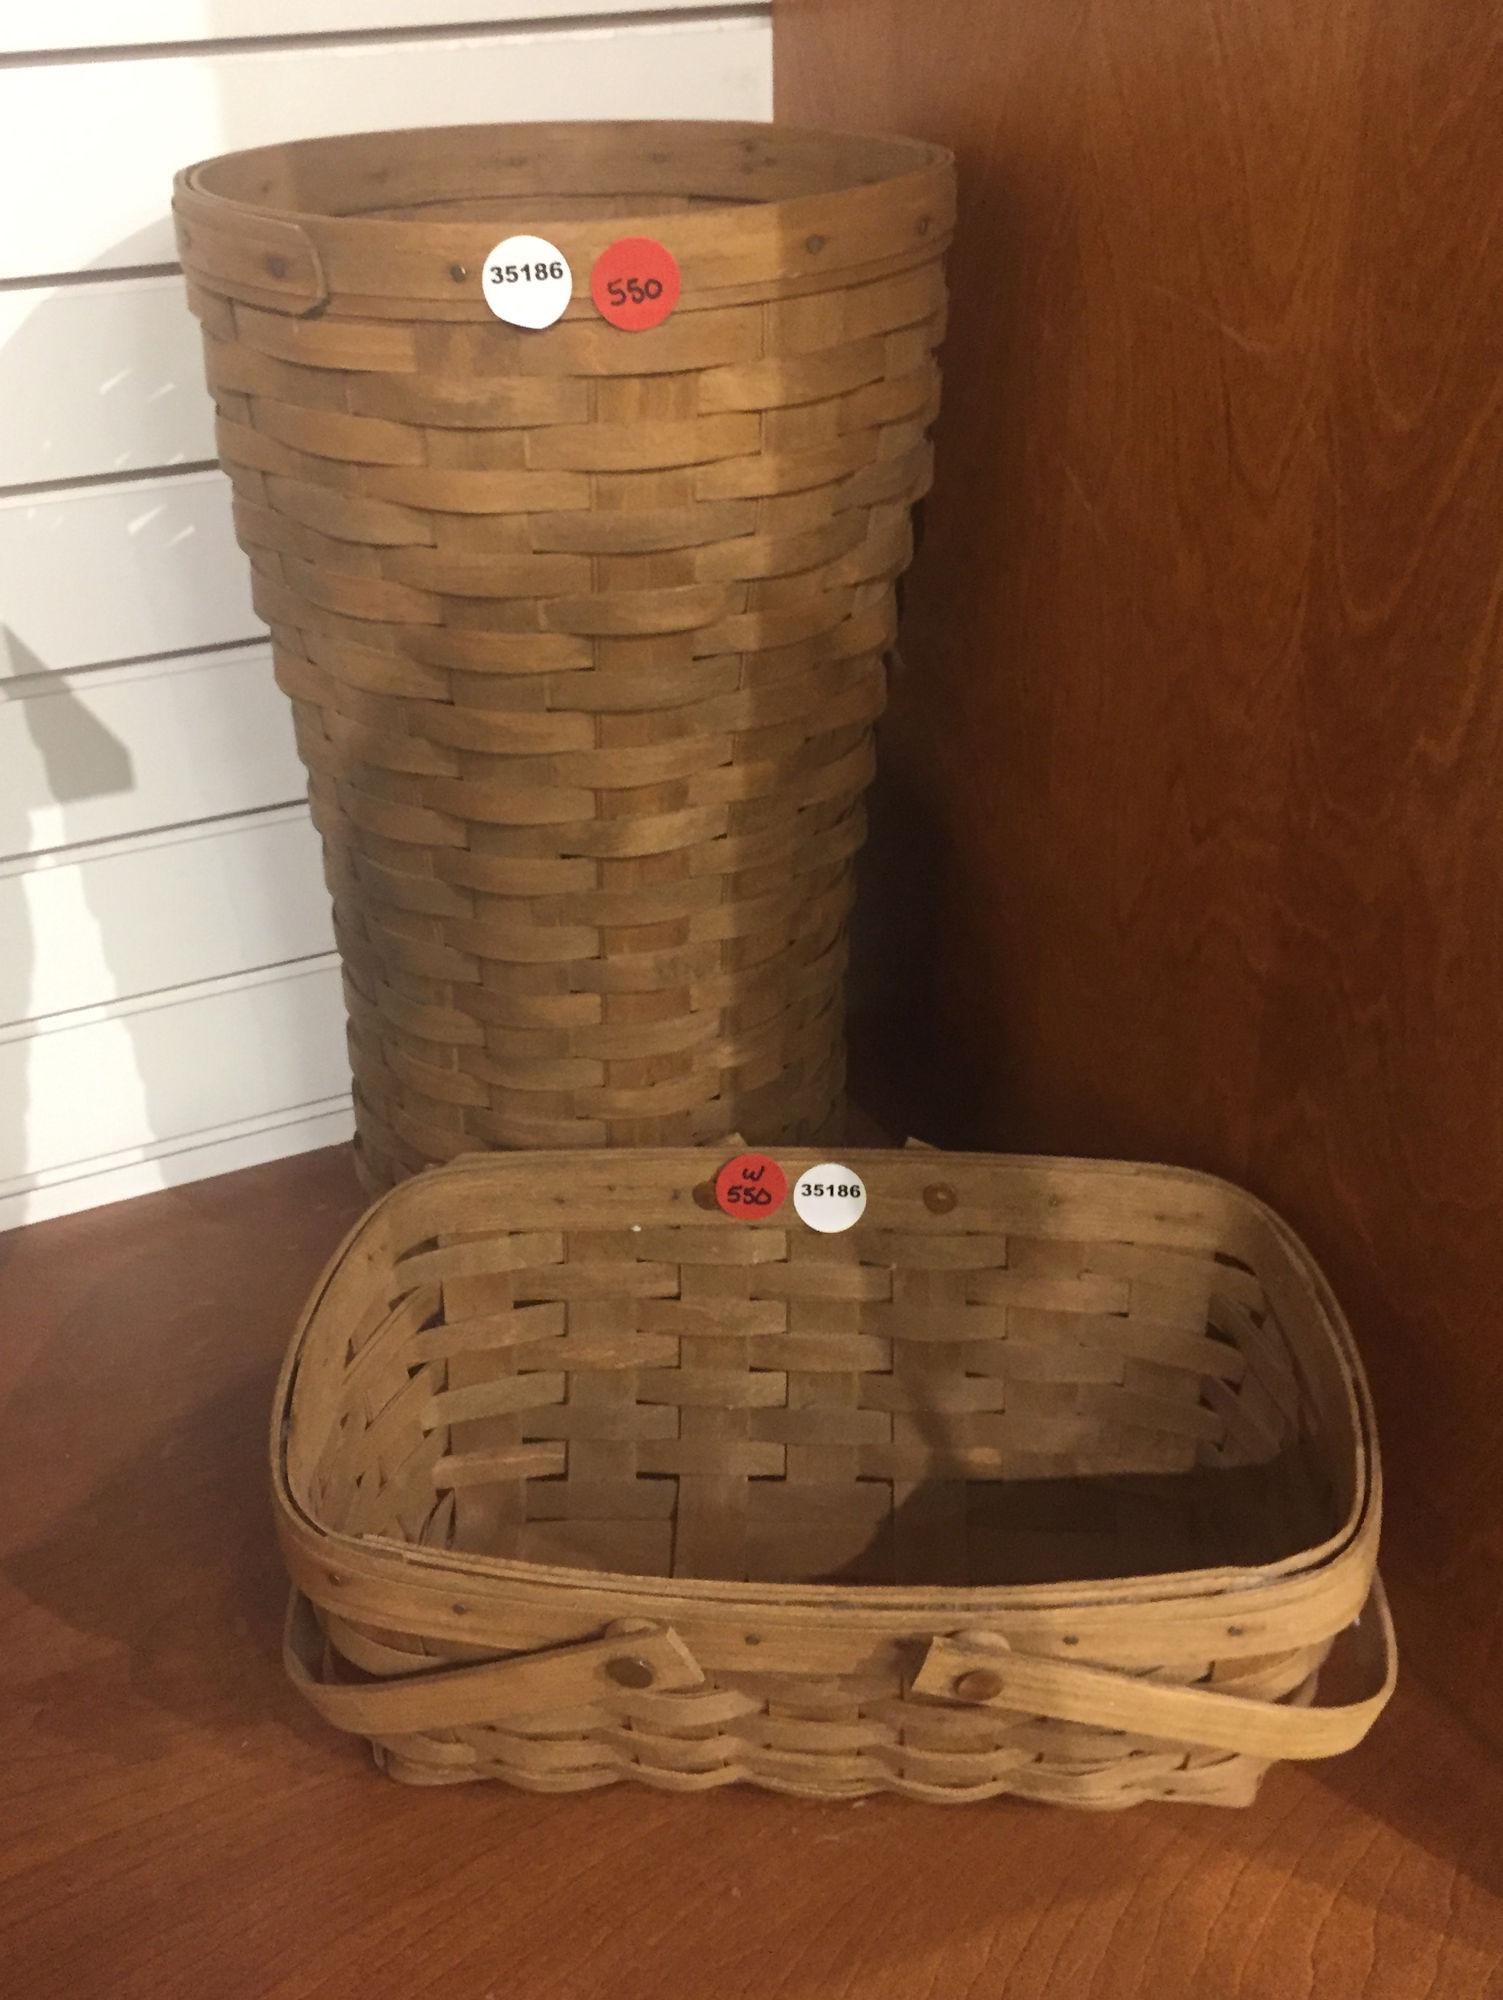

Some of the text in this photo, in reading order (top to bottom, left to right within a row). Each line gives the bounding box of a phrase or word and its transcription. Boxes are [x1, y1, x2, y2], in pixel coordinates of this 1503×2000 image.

[490, 262, 563, 284] 35186
[607, 278, 663, 306] 550
[727, 1185, 772, 1205] 550
[801, 1183, 861, 1198] 35186
